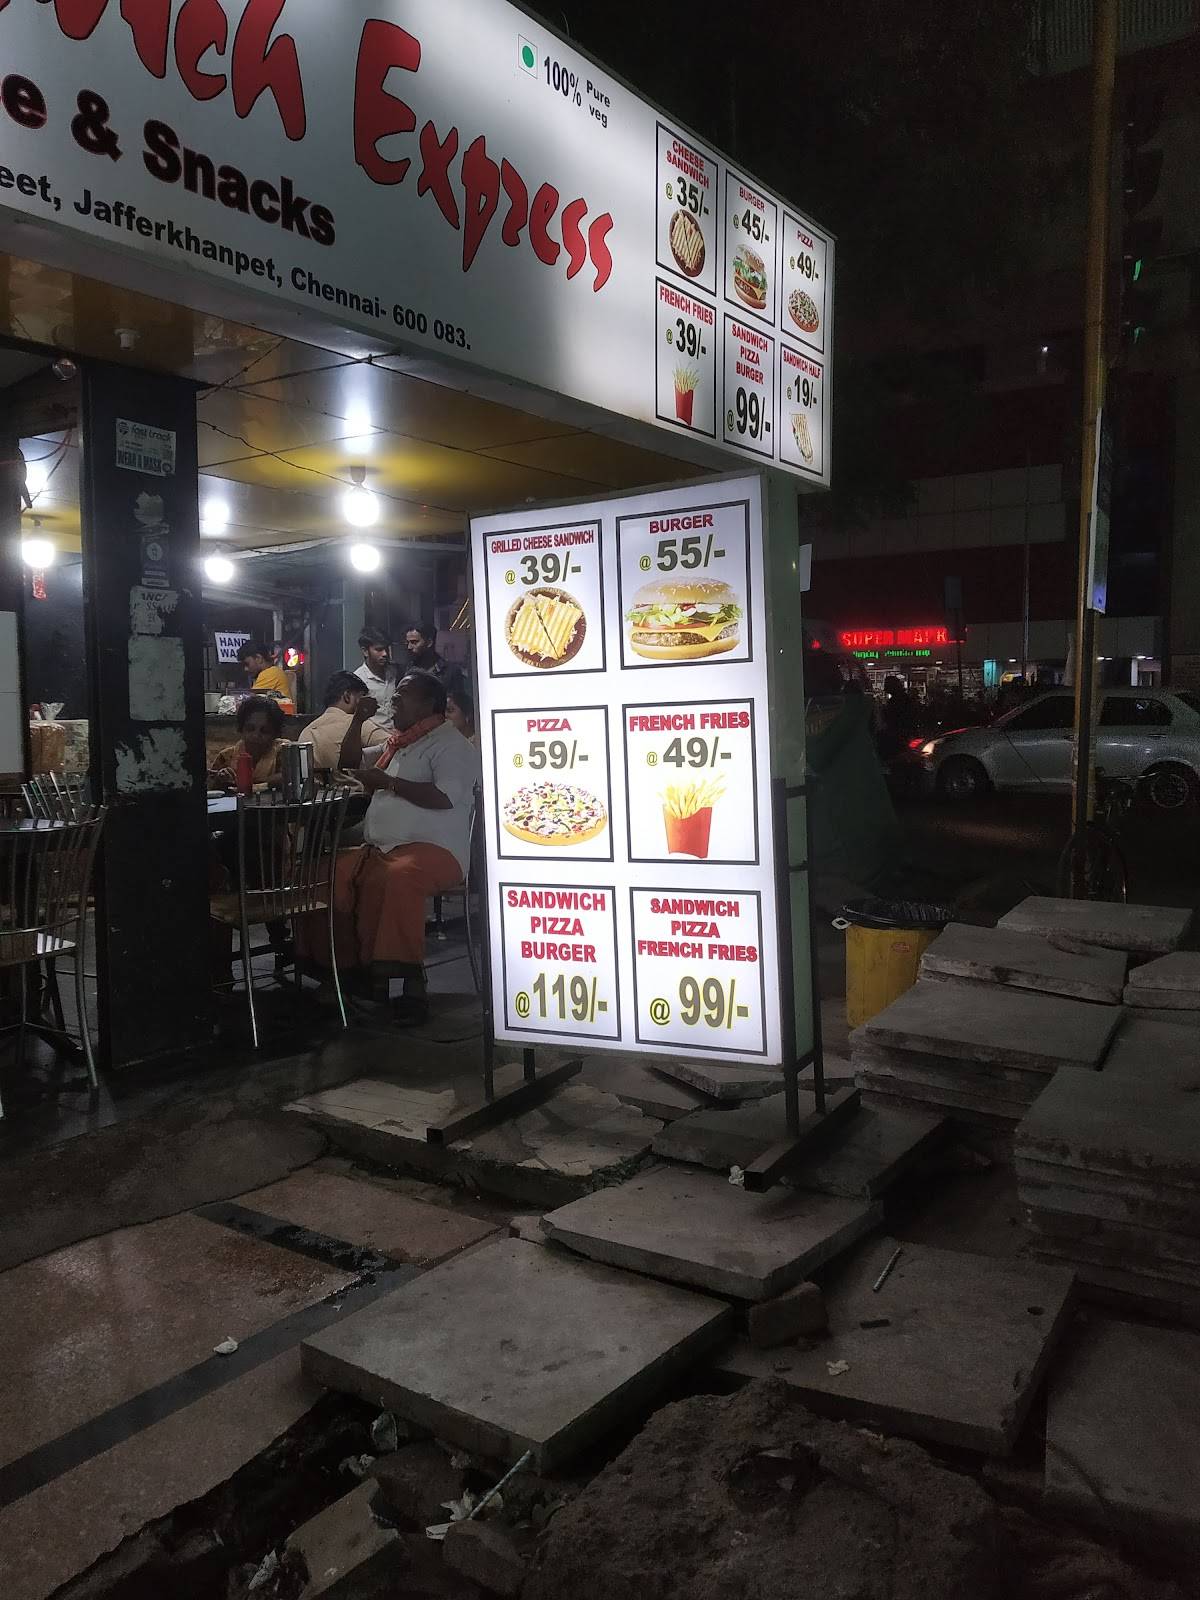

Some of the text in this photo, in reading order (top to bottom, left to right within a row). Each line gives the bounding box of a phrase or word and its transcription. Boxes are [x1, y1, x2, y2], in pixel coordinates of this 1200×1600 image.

[544, 56, 582, 107] 100%
[586, 80, 611, 108] Pure
[589, 104, 608, 128] veg
[354, 18, 614, 293] Express
[672, 140, 705, 171] CHEESE
[71, 90, 123, 162] &
[143, 120, 336, 247] Snacks
[666, 150, 709, 189] SANDWICH
[739, 187, 765, 213] BURGER
[797, 230, 814, 250] PIZZA
[73, 189, 282, 288] Jafferkhanpet,
[291, 267, 386, 319] Chennai-
[393, 304, 427, 334] 600
[433, 319, 471, 350] 083.
[659, 285, 713, 325] FRENCH FRIES
[732, 323, 768, 352] SANDWICH
[740, 346, 760, 366] PIZZA
[783, 349, 821, 379] SANDWICH HALF
[736, 361, 764, 385] BURGER
[649, 513, 714, 534] BURGER
[491, 529, 594, 554] GRILLED CHEESE SANDWICH
[527, 718, 572, 732] PIZZA
[629, 711, 750, 731] FRENCH FRIES
[507, 890, 606, 911] SANDWICH
[650, 898, 740, 917] SANDWICH
[530, 916, 585, 936] PIZZA
[671, 920, 720, 938] PIZZA
[521, 940, 597, 963] BURGER
[637, 940, 758, 962] FRENCH FRIES
